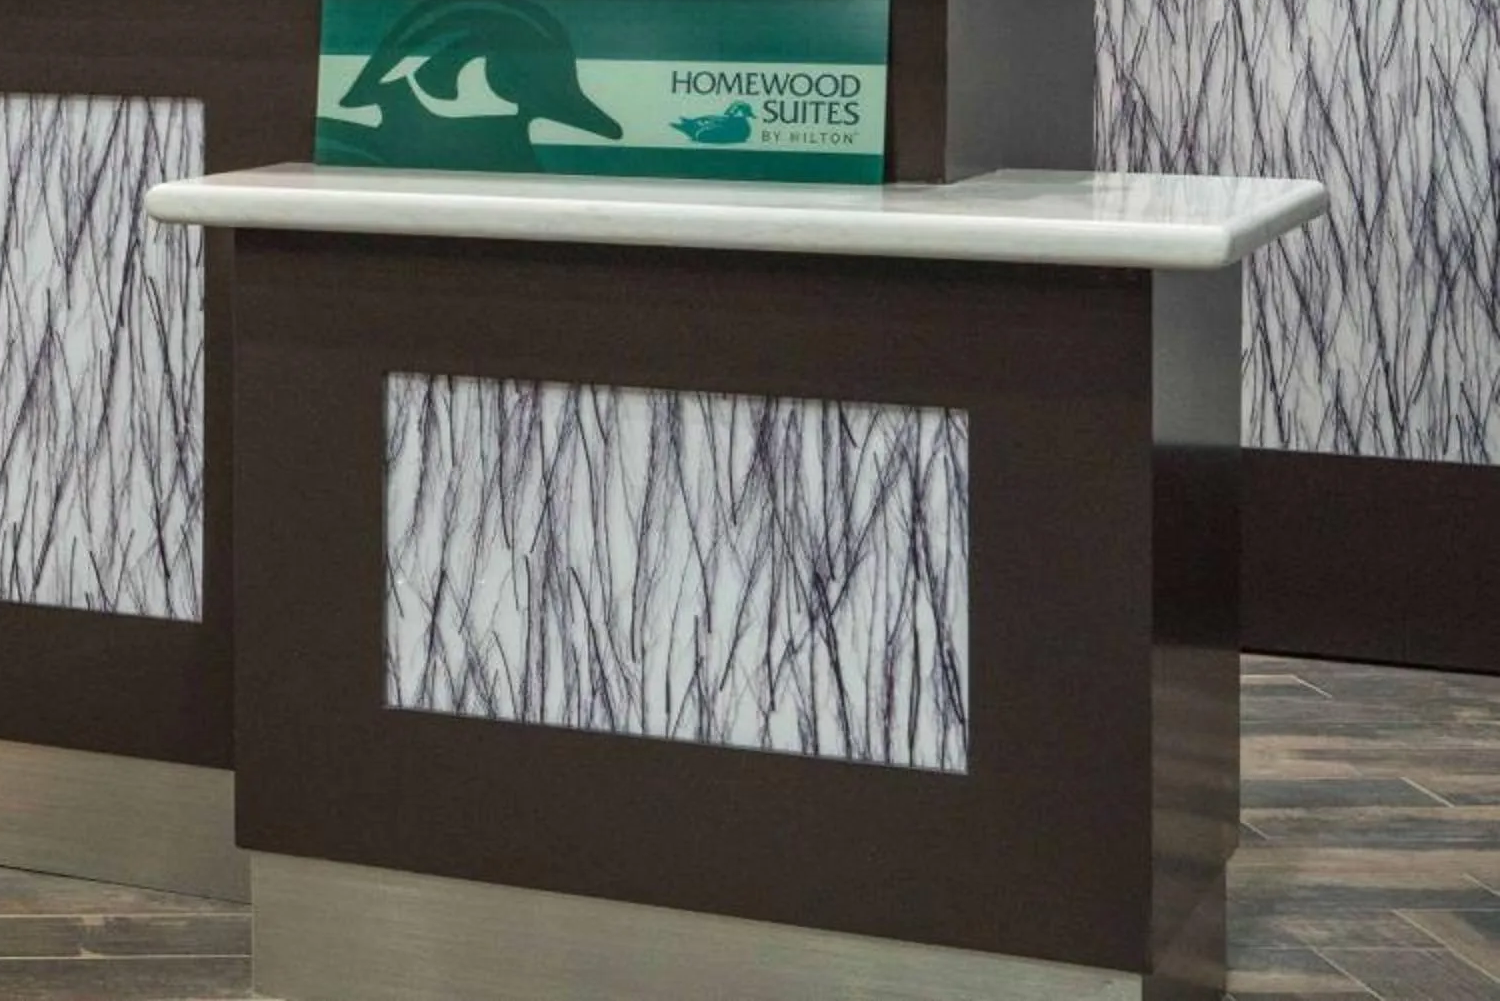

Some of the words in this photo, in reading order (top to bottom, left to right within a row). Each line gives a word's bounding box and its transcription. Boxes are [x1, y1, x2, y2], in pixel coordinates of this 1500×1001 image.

[671, 70, 861, 97] HOMEWOOD
[762, 99, 860, 126] SUITES
[761, 130, 780, 142] BY
[790, 132, 854, 144] HILTON
